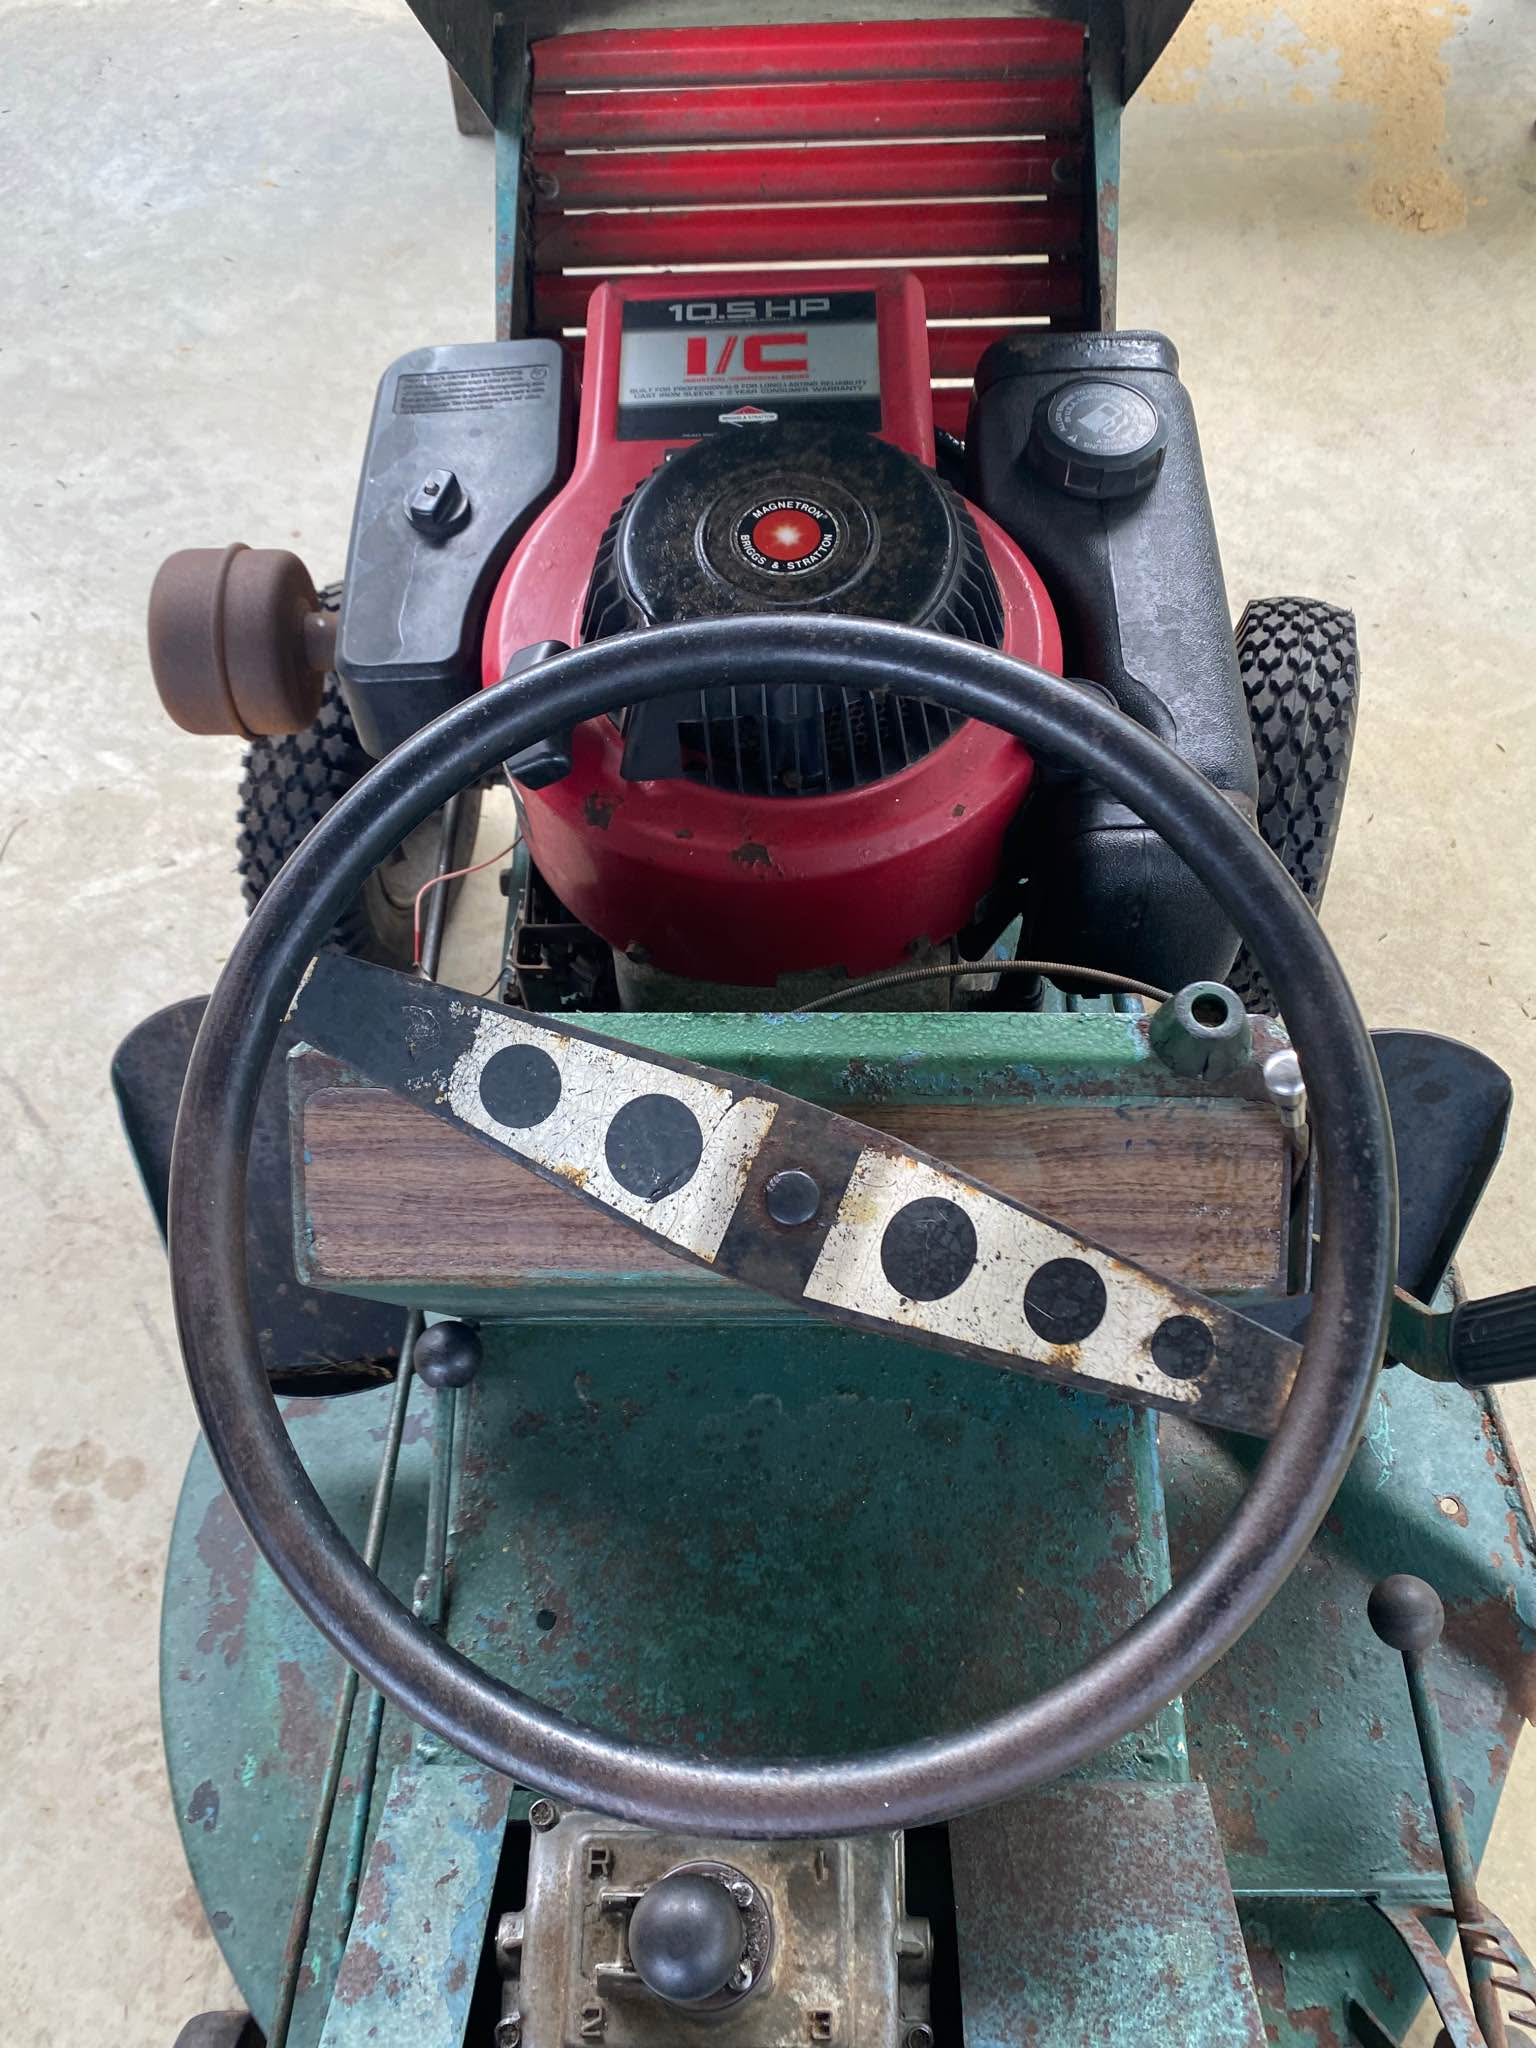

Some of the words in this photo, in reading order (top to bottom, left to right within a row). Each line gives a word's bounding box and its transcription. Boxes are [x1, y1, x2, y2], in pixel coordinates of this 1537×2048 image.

[668, 300, 758, 322] 10.5
[765, 297, 831, 318] HP
[686, 332, 809, 376] I/C
[752, 501, 824, 519] MAGNETRON
[740, 534, 767, 565] BRIGGS
[771, 561, 780, 569] &
[786, 533, 833, 570] STRATTON
[588, 1847, 611, 1879] R
